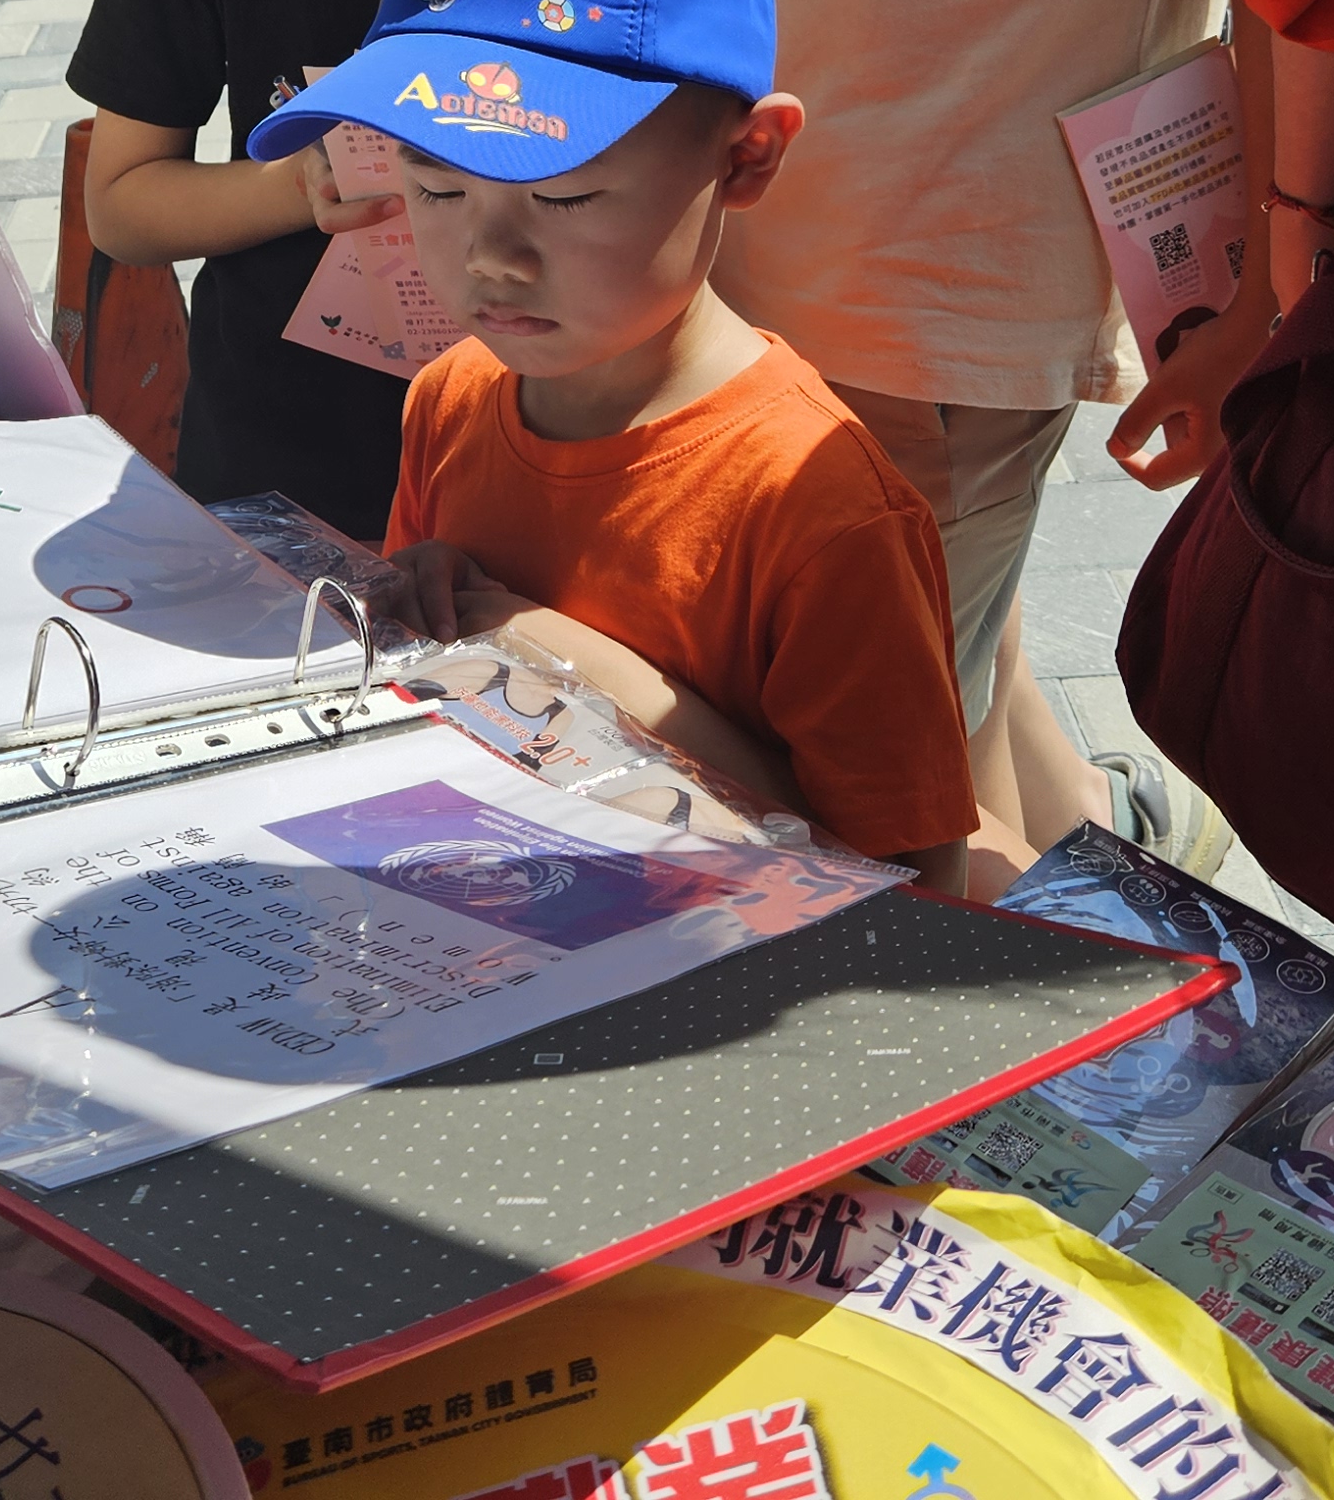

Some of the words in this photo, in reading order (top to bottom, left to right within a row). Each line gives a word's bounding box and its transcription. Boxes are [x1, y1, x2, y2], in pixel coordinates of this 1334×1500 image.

[473, 816, 541, 846] Elimination
[478, 808, 524, 830] Women
[520, 825, 569, 845] against
[538, 841, 563, 853] the
[93, 846, 141, 869] of
[138, 835, 254, 899] against
[559, 848, 581, 858] on
[66, 855, 113, 889] the
[120, 893, 159, 914] on
[136, 869, 212, 910] Forms
[201, 906, 260, 930] All
[165, 916, 320, 986] Convention
[245, 926, 291, 946] of
[261, 902, 503, 1000] Discrimination
[292, 941, 465, 1014] Elimination
[236, 1017, 337, 1056] CEDAW
[711, 1193, 1307, 1500] 就業機會的
[281, 1356, 598, 1470] 臺南市政府體育局
[471, 1414, 502, 1432] CITY
